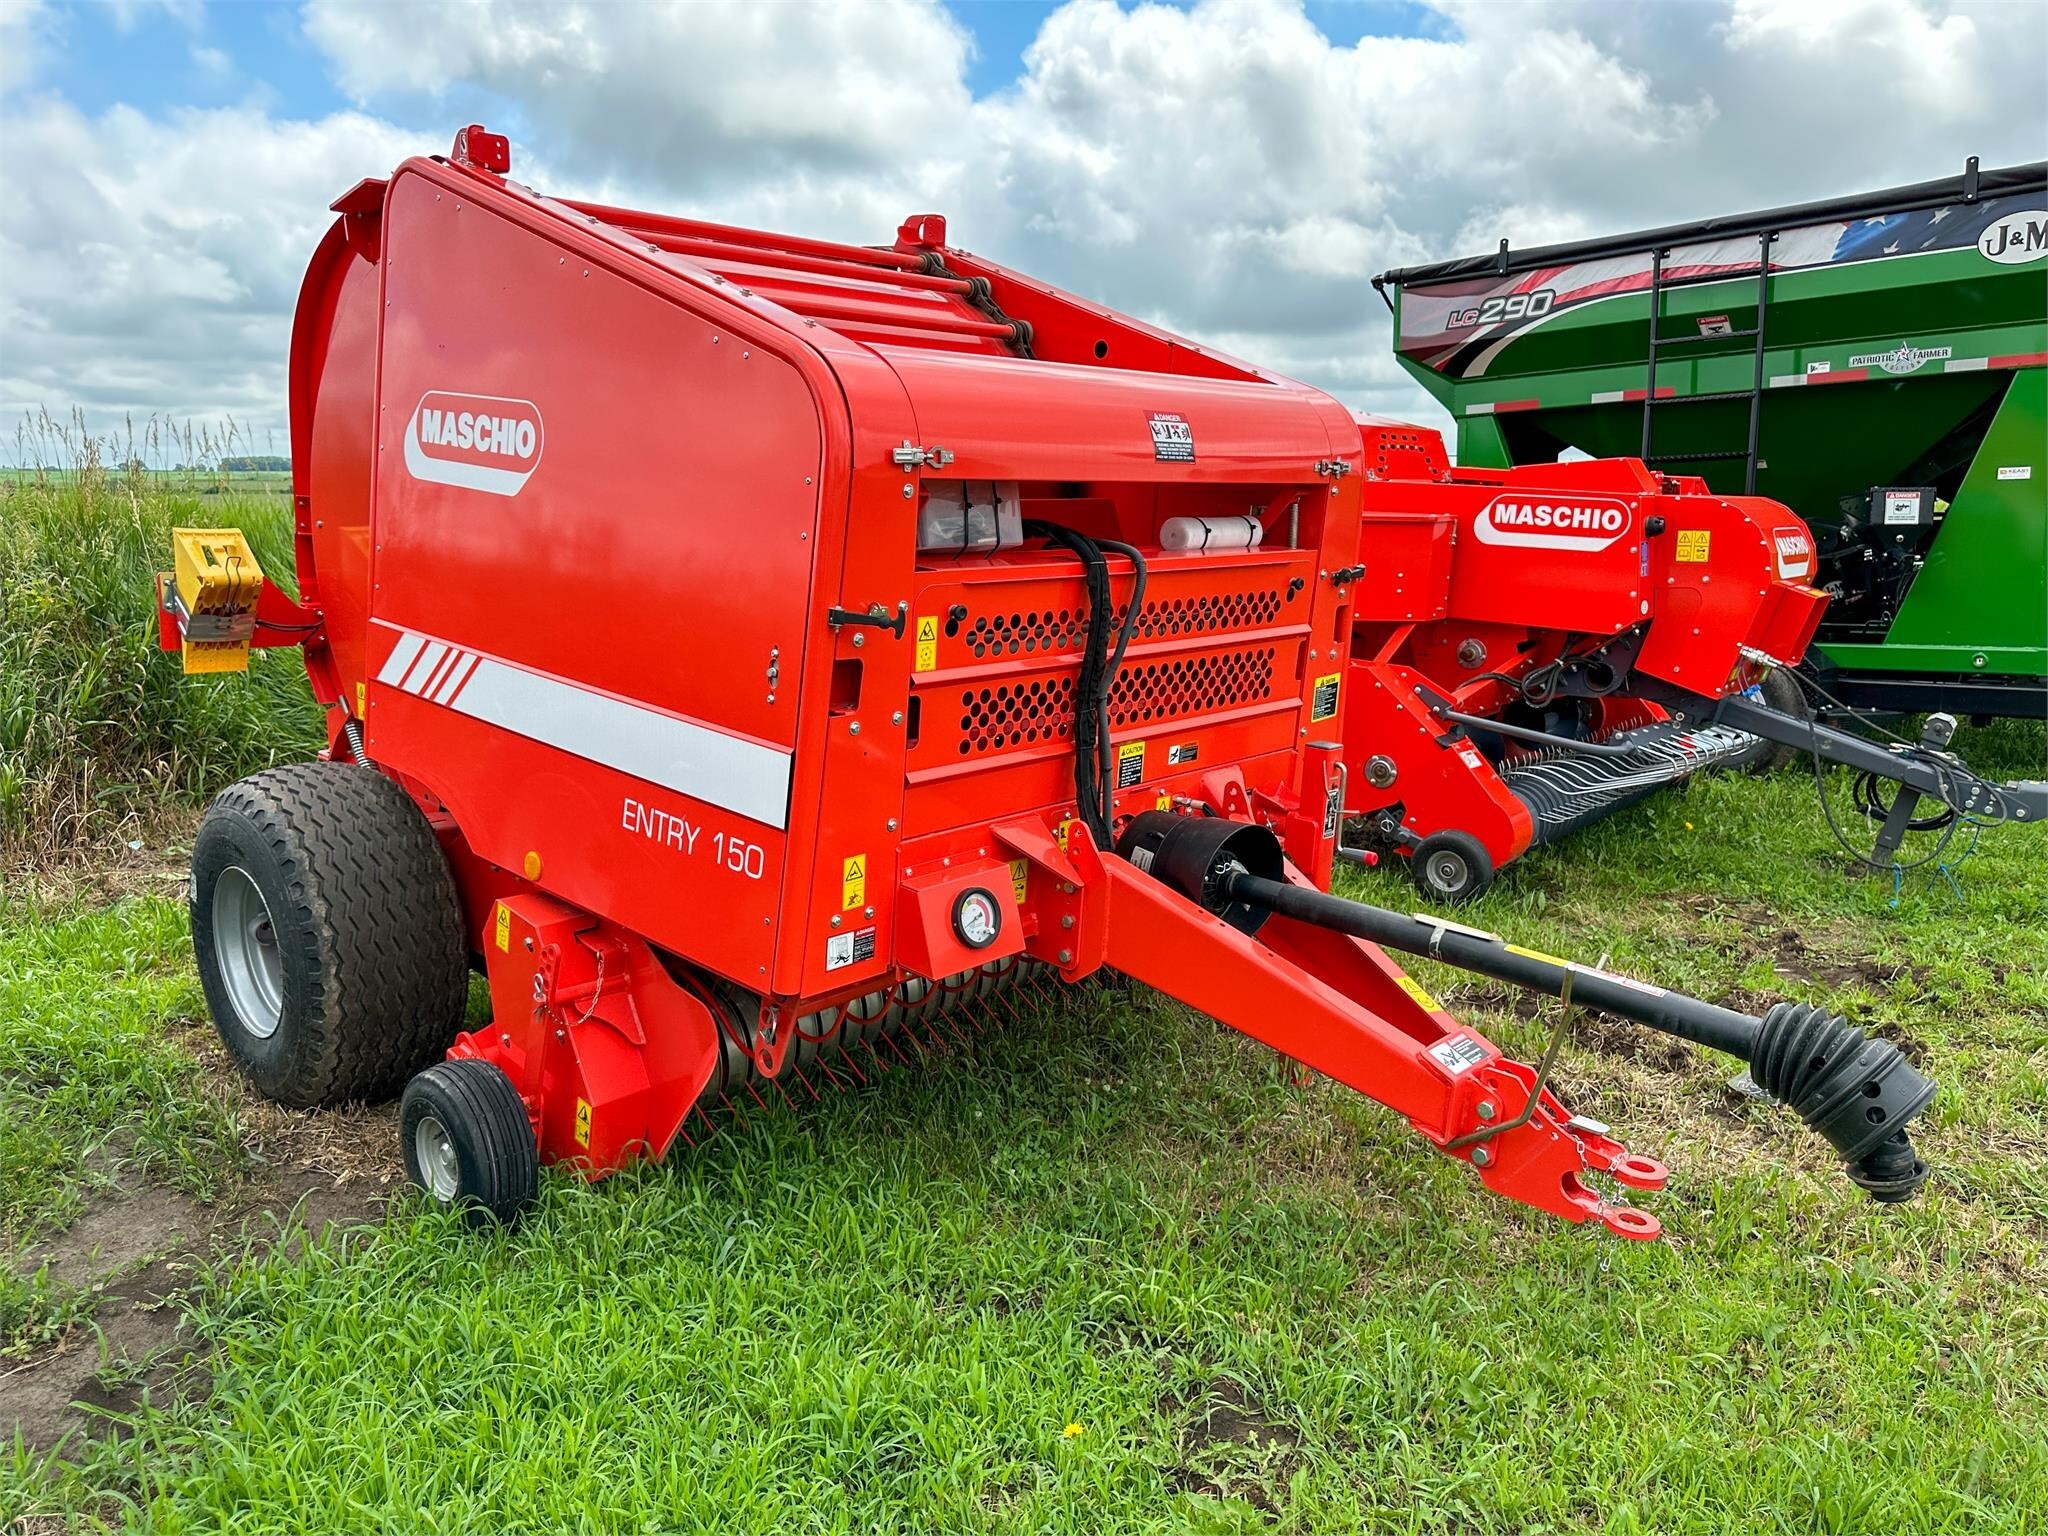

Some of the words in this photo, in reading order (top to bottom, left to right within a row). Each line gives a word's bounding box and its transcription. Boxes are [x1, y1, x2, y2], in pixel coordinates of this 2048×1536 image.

[1852, 354, 1895, 366] PATRIOTIC
[1913, 348, 1949, 360] FARMER
[421, 408, 536, 460] MASCHIO
[1494, 503, 1623, 531] MASCHIO
[1776, 535, 1810, 557] MASCHIO
[1126, 745, 1143, 755] CAUTION
[622, 797, 701, 856] ENTRY
[713, 832, 765, 880] 150
